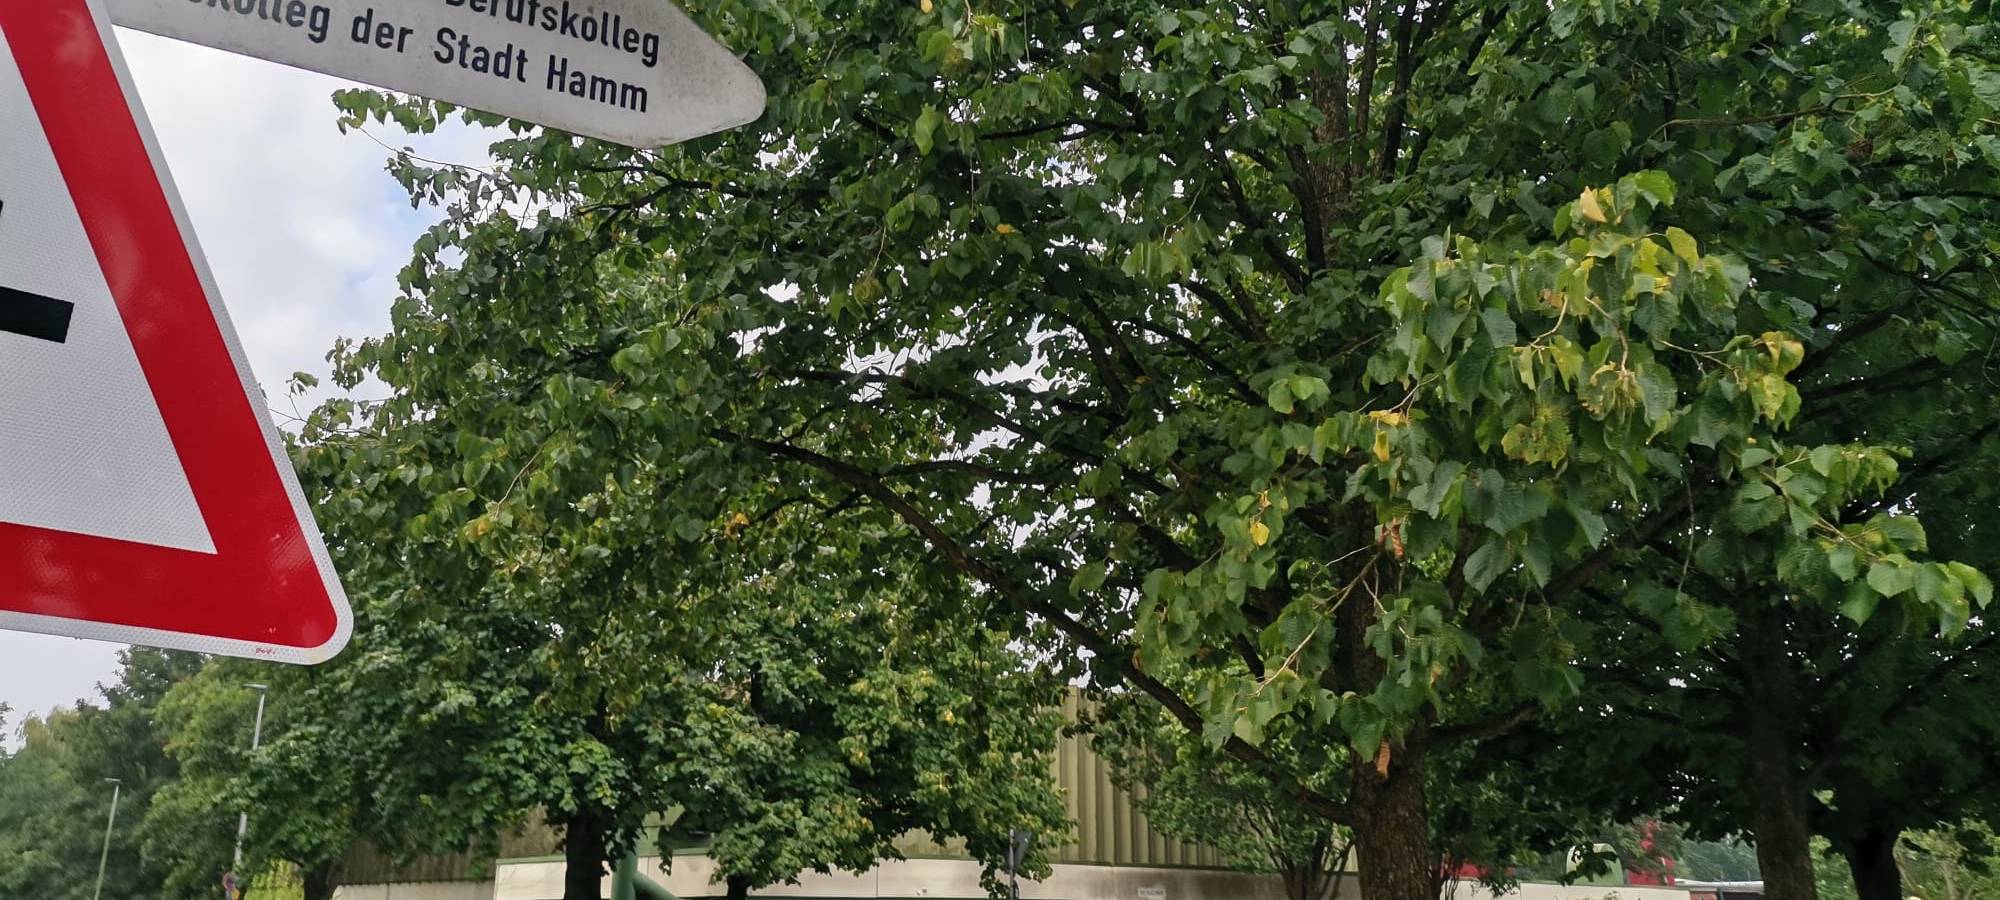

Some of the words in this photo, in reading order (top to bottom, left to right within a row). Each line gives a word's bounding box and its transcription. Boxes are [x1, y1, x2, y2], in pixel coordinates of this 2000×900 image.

[351, 8, 413, 53] der
[434, 27, 528, 83] Stadt
[546, 54, 648, 113] Hamm
